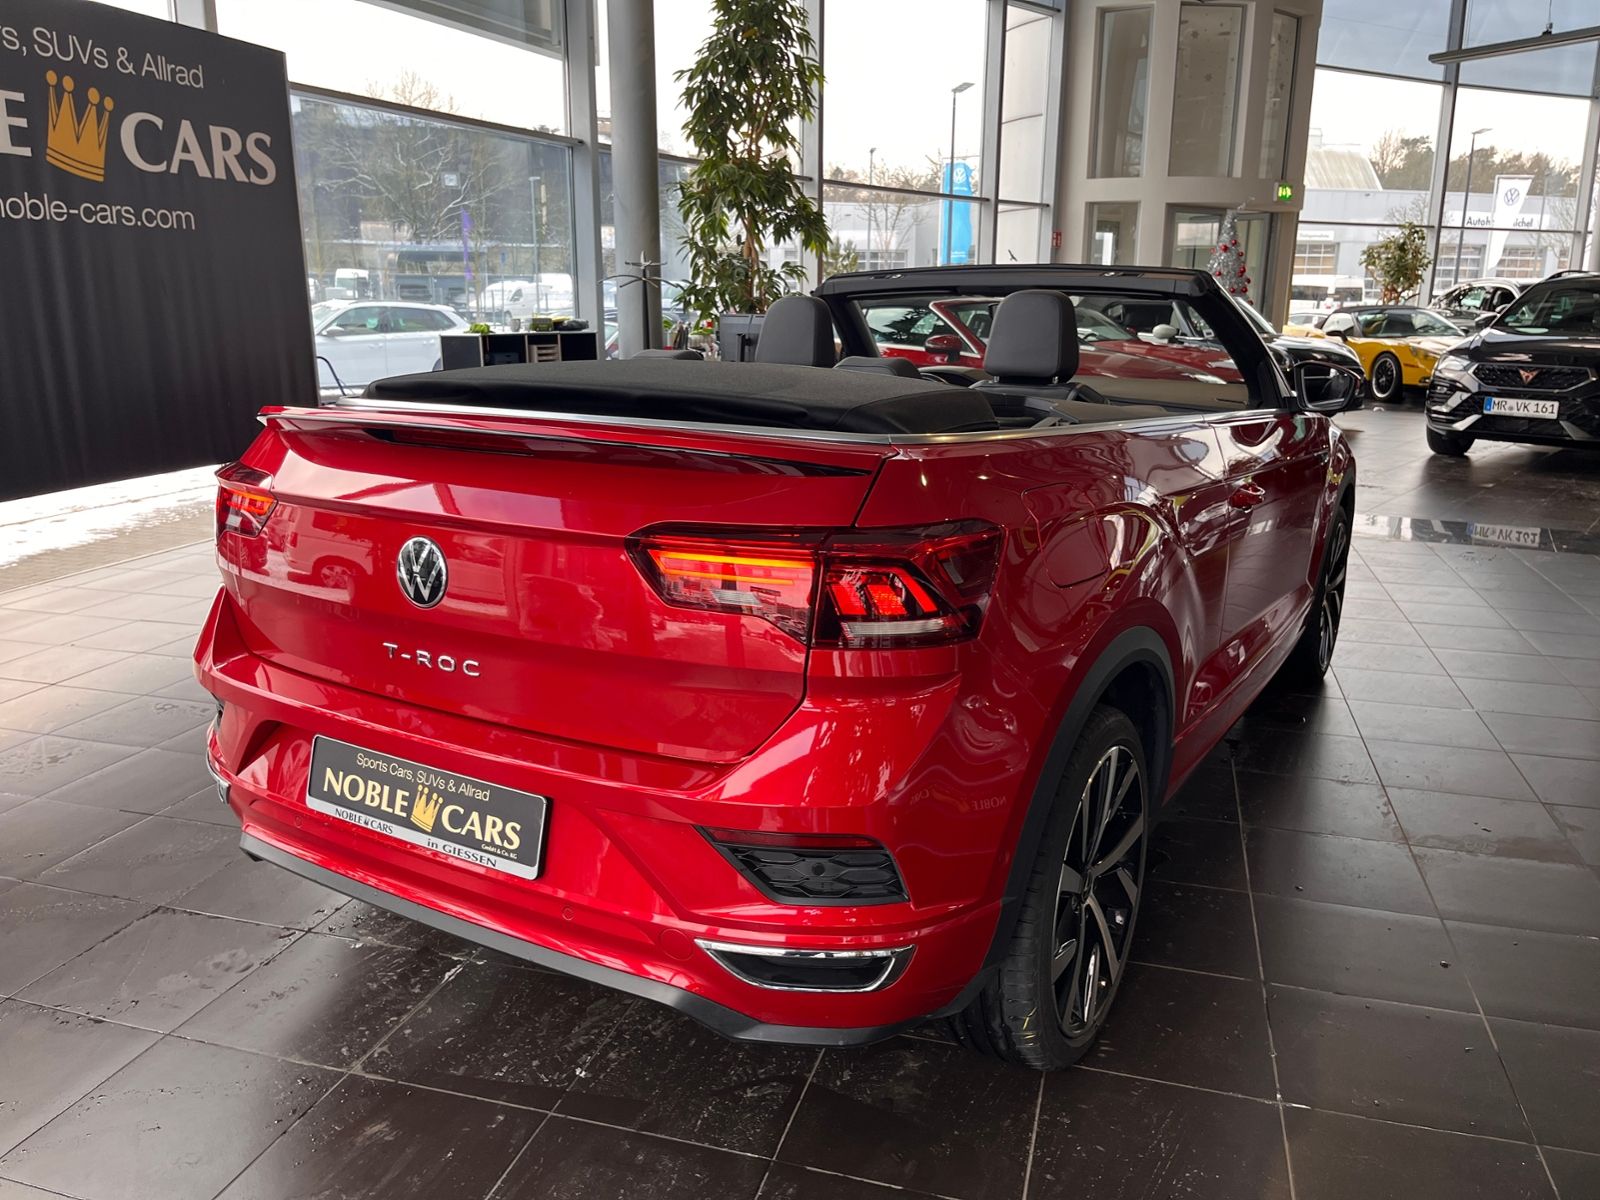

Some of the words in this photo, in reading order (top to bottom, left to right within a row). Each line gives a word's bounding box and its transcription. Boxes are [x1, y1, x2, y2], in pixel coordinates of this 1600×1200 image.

[33, 27, 108, 69] SUVs
[116, 47, 136, 75] &
[141, 52, 204, 88] Allrad
[120, 112, 276, 186] CARS
[1492, 400, 1508, 411] MR
[1516, 401, 1531, 413] VK
[1533, 402, 1555, 415] 161
[383, 642, 480, 677] T-ROC
[356, 753, 388, 773] Sports
[389, 763, 415, 783] Cars,
[416, 770, 446, 790] SUVs
[447, 779, 457, 793] &
[458, 782, 491, 802] Allrad
[323, 767, 410, 817] NOBLE
[441, 804, 521, 850] CARS
[335, 808, 363, 825] NOBLE
[370, 821, 394, 835] CARS
[427, 838, 438, 849] in
[442, 843, 498, 868] GIESSEN
